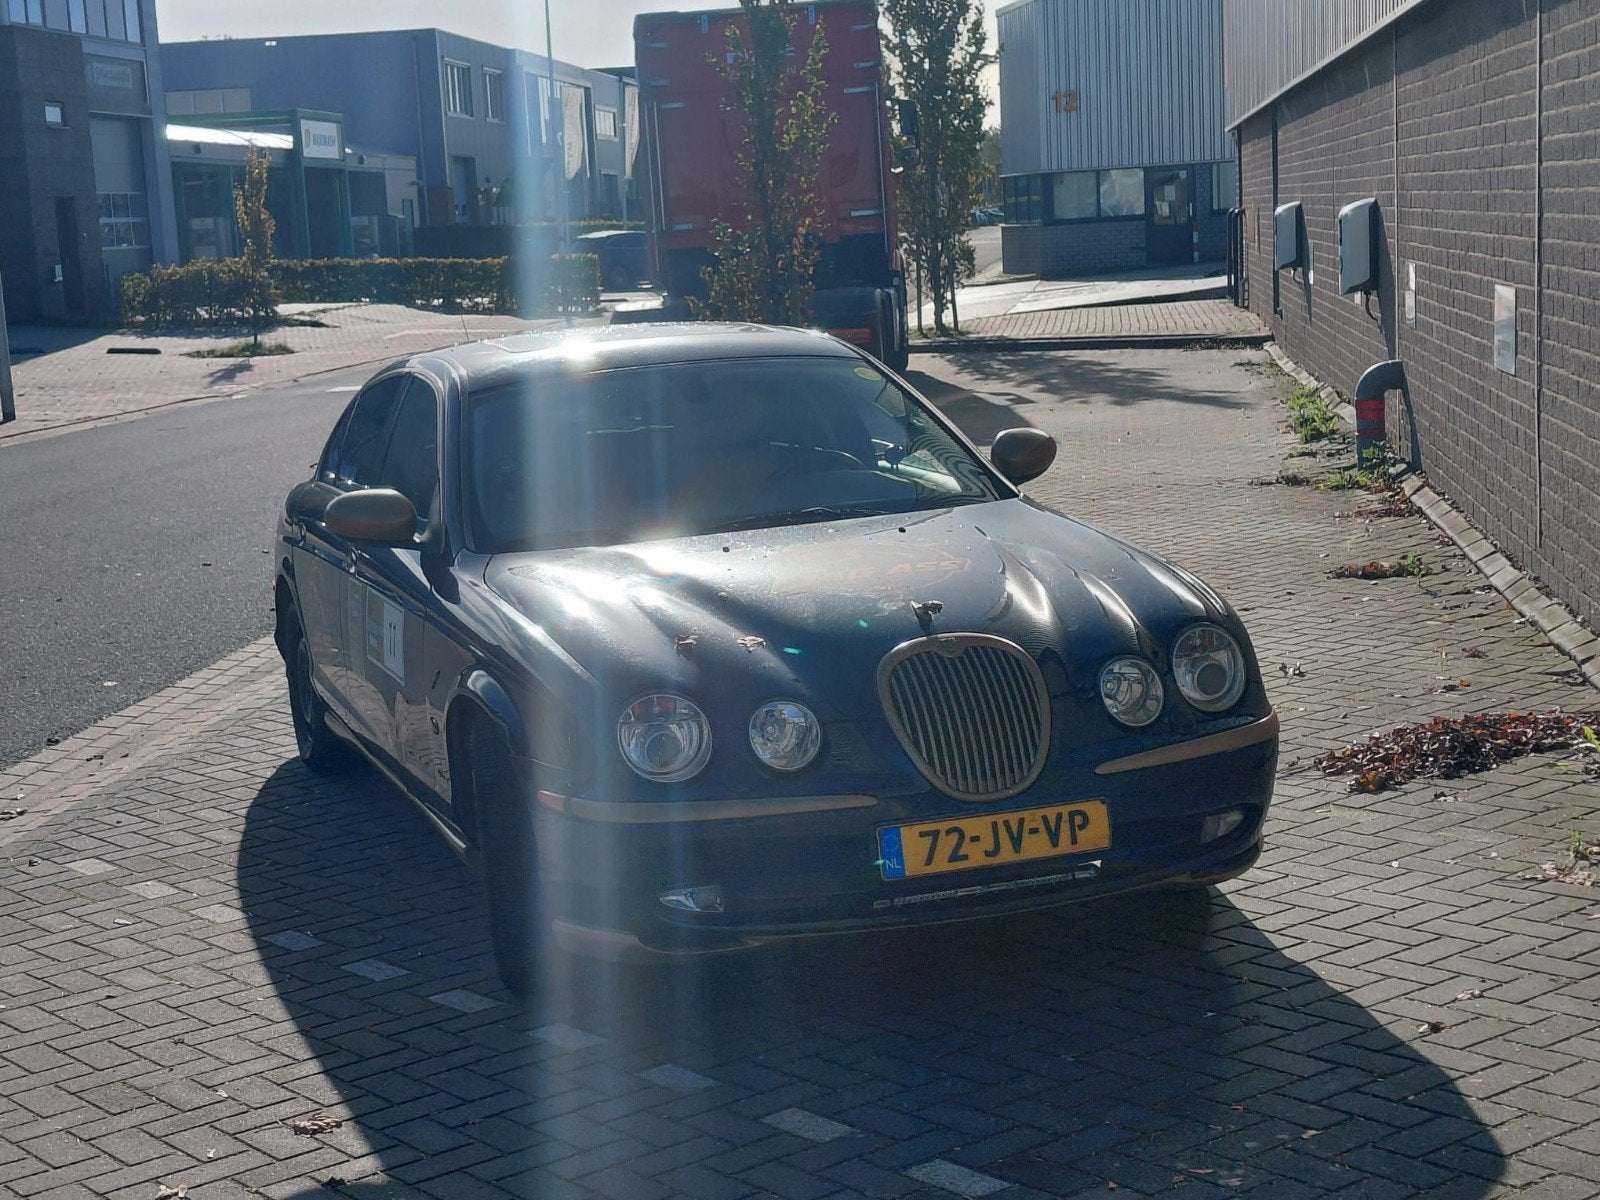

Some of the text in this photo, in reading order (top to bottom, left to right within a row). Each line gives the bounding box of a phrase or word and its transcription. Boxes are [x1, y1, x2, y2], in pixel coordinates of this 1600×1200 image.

[1051, 90, 1078, 113] 12
[918, 809, 1090, 867] 72-JV-VP
[885, 859, 901, 870] NL
